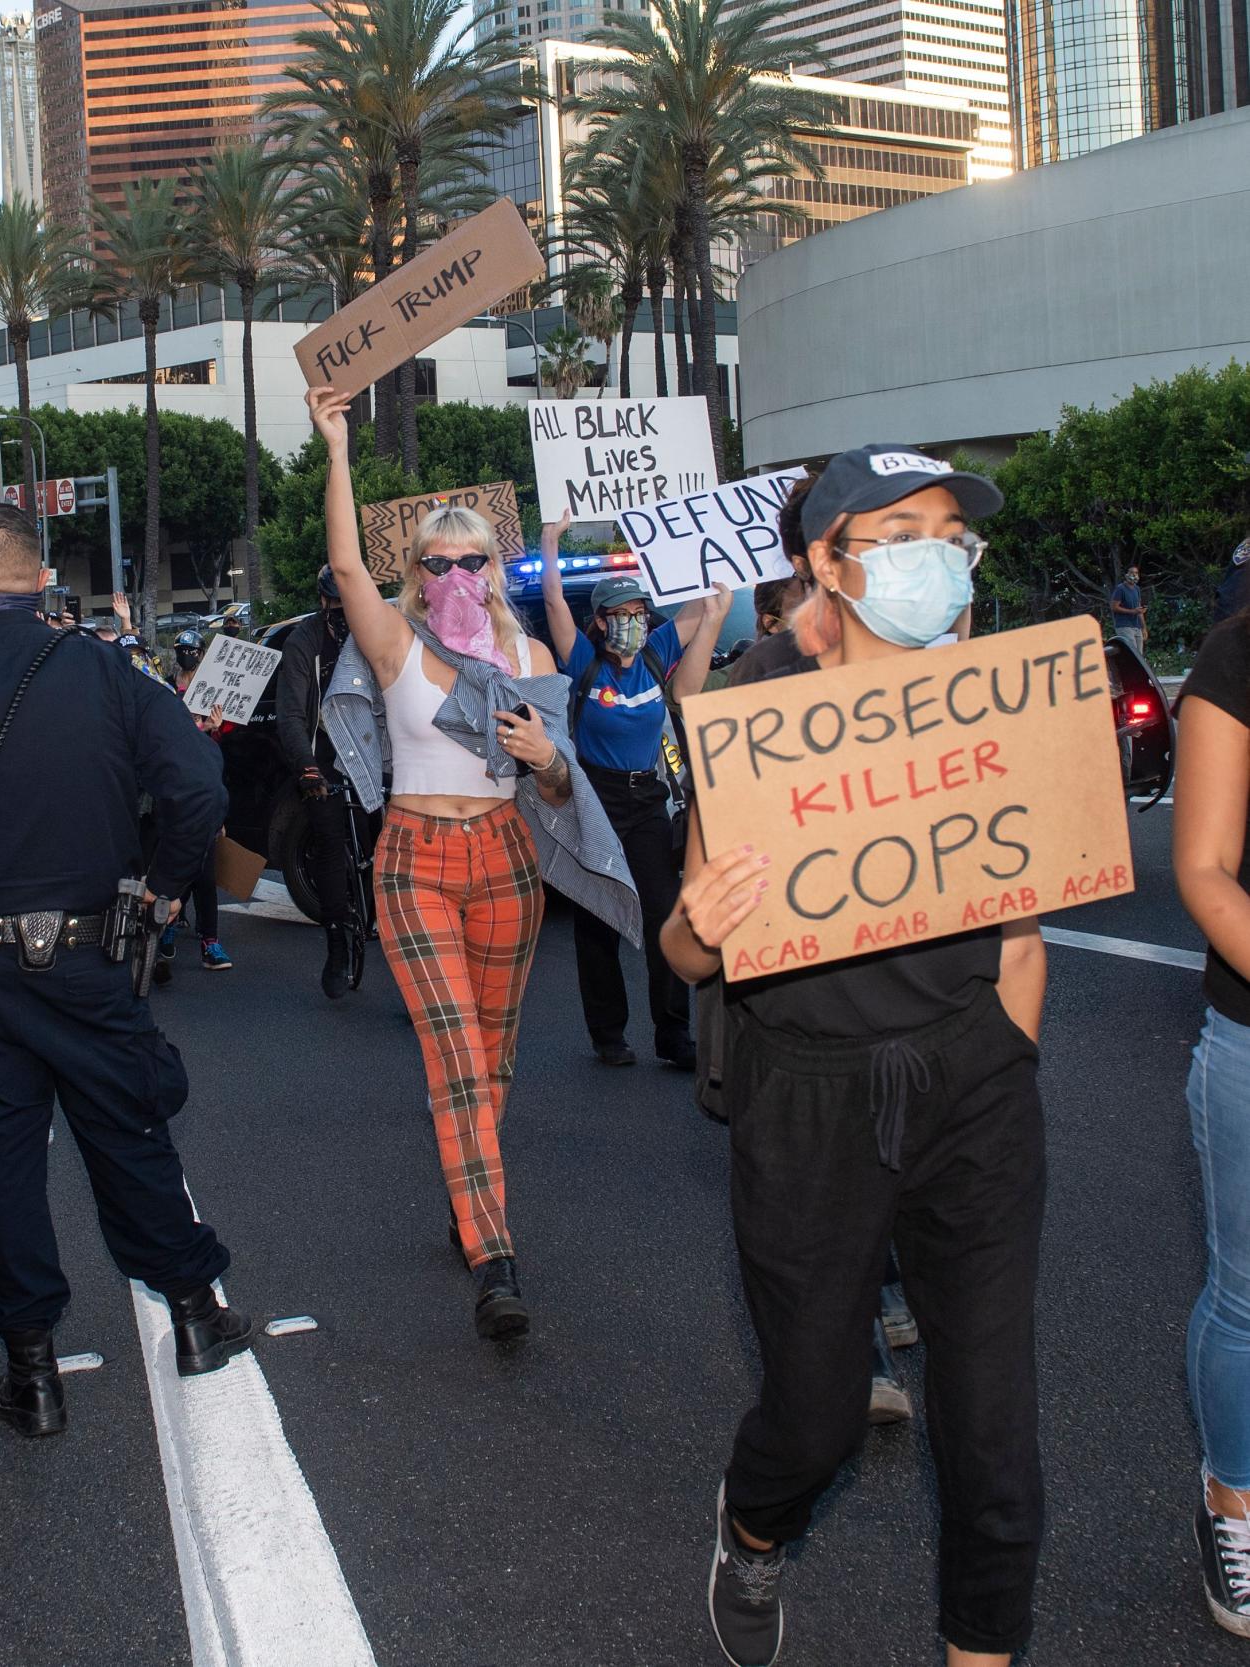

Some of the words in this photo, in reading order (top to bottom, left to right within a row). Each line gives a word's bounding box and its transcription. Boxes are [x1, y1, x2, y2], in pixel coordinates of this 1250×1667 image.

[35, 6, 62, 30] CBRE
[315, 320, 385, 382] FUCK
[391, 250, 482, 322] TRUMP
[534, 406, 567, 441] ALL
[575, 403, 659, 440] BLACK
[882, 456, 941, 471] BLM
[640, 525, 779, 596] LAP
[189, 680, 252, 719] POLICE
[222, 670, 245, 687] THE
[697, 637, 1104, 788] PROSECUTE
[790, 739, 1009, 827] KILLER
[785, 804, 1031, 921] COPS
[731, 934, 821, 977] ACAB
[853, 911, 930, 950] ACAB
[961, 886, 1038, 927] ACAB
[1062, 864, 1129, 902] ACAB
